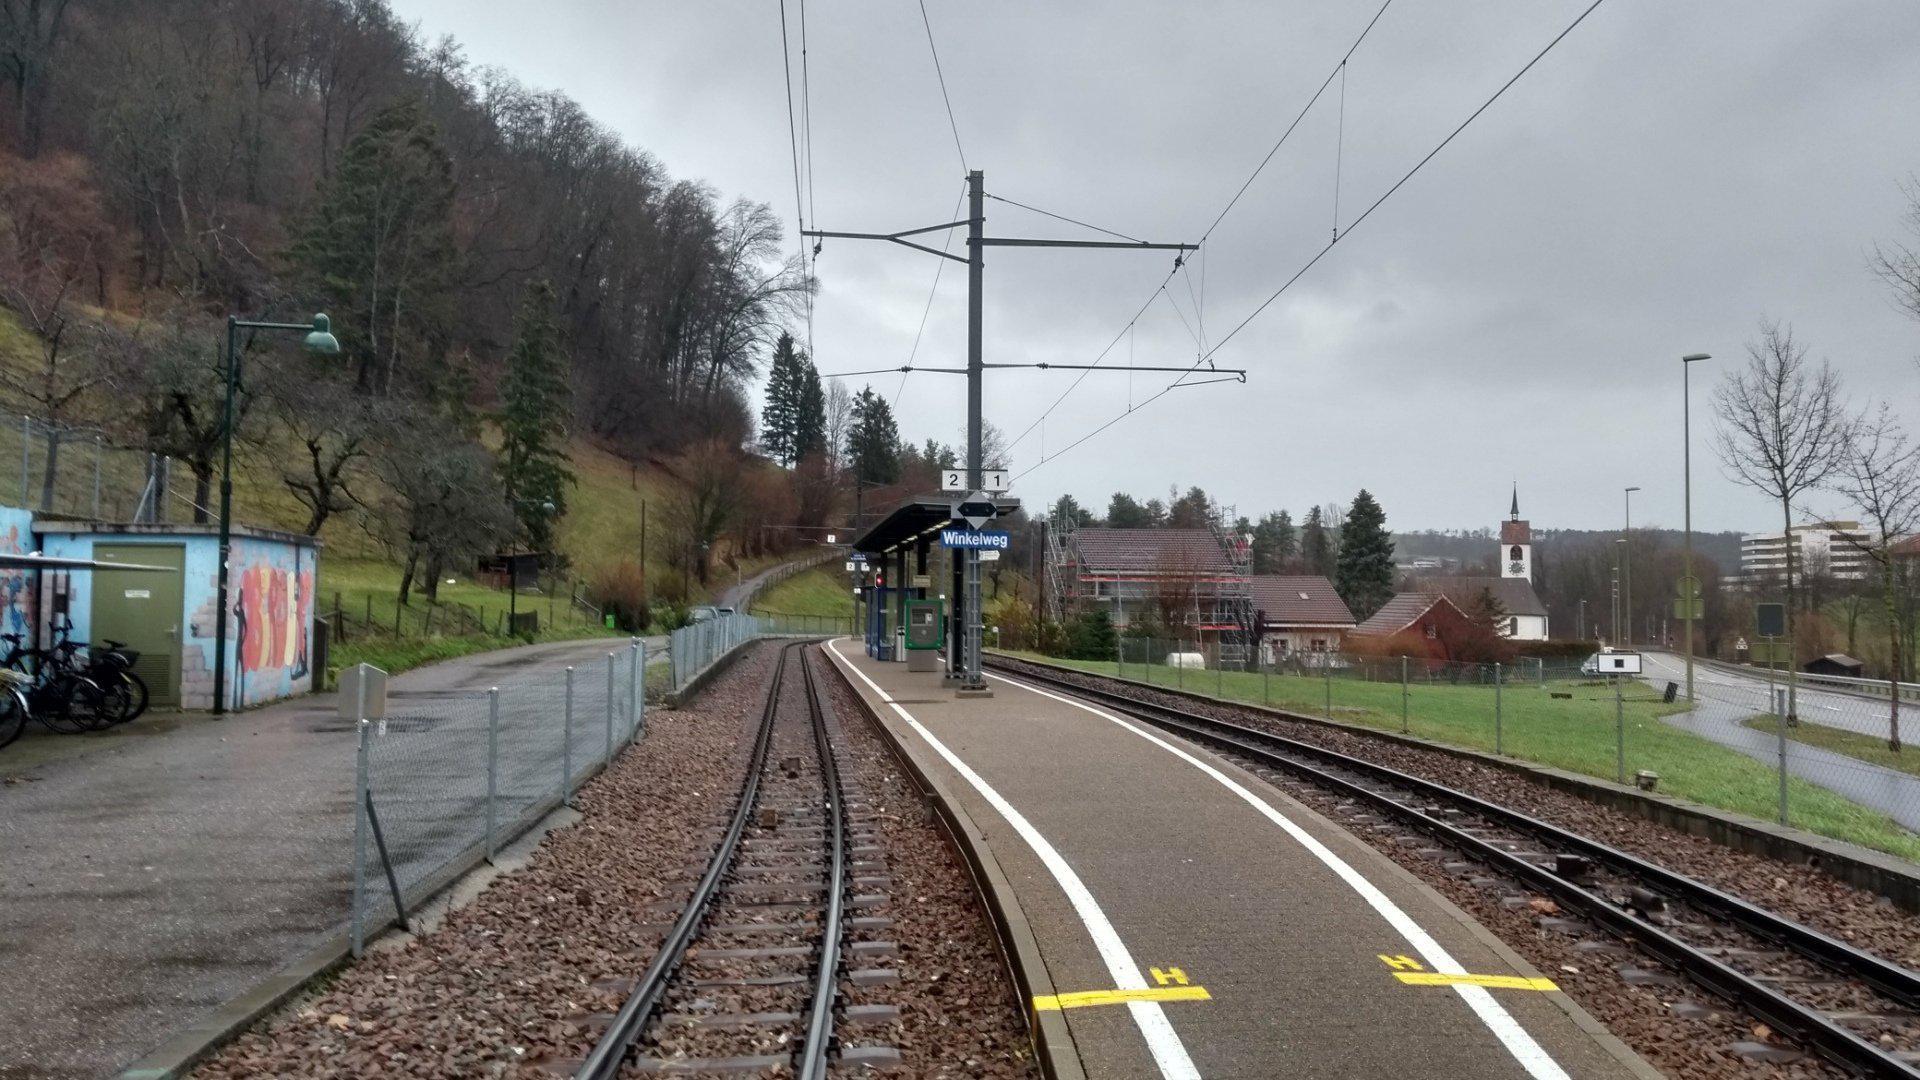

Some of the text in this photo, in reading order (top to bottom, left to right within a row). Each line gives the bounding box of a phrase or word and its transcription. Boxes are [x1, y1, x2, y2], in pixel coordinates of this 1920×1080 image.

[949, 473, 958, 486] 2
[994, 475, 1000, 487] 1
[943, 531, 1008, 548] Winkelweg
[1376, 953, 1423, 970] H
[1149, 966, 1188, 985] H
